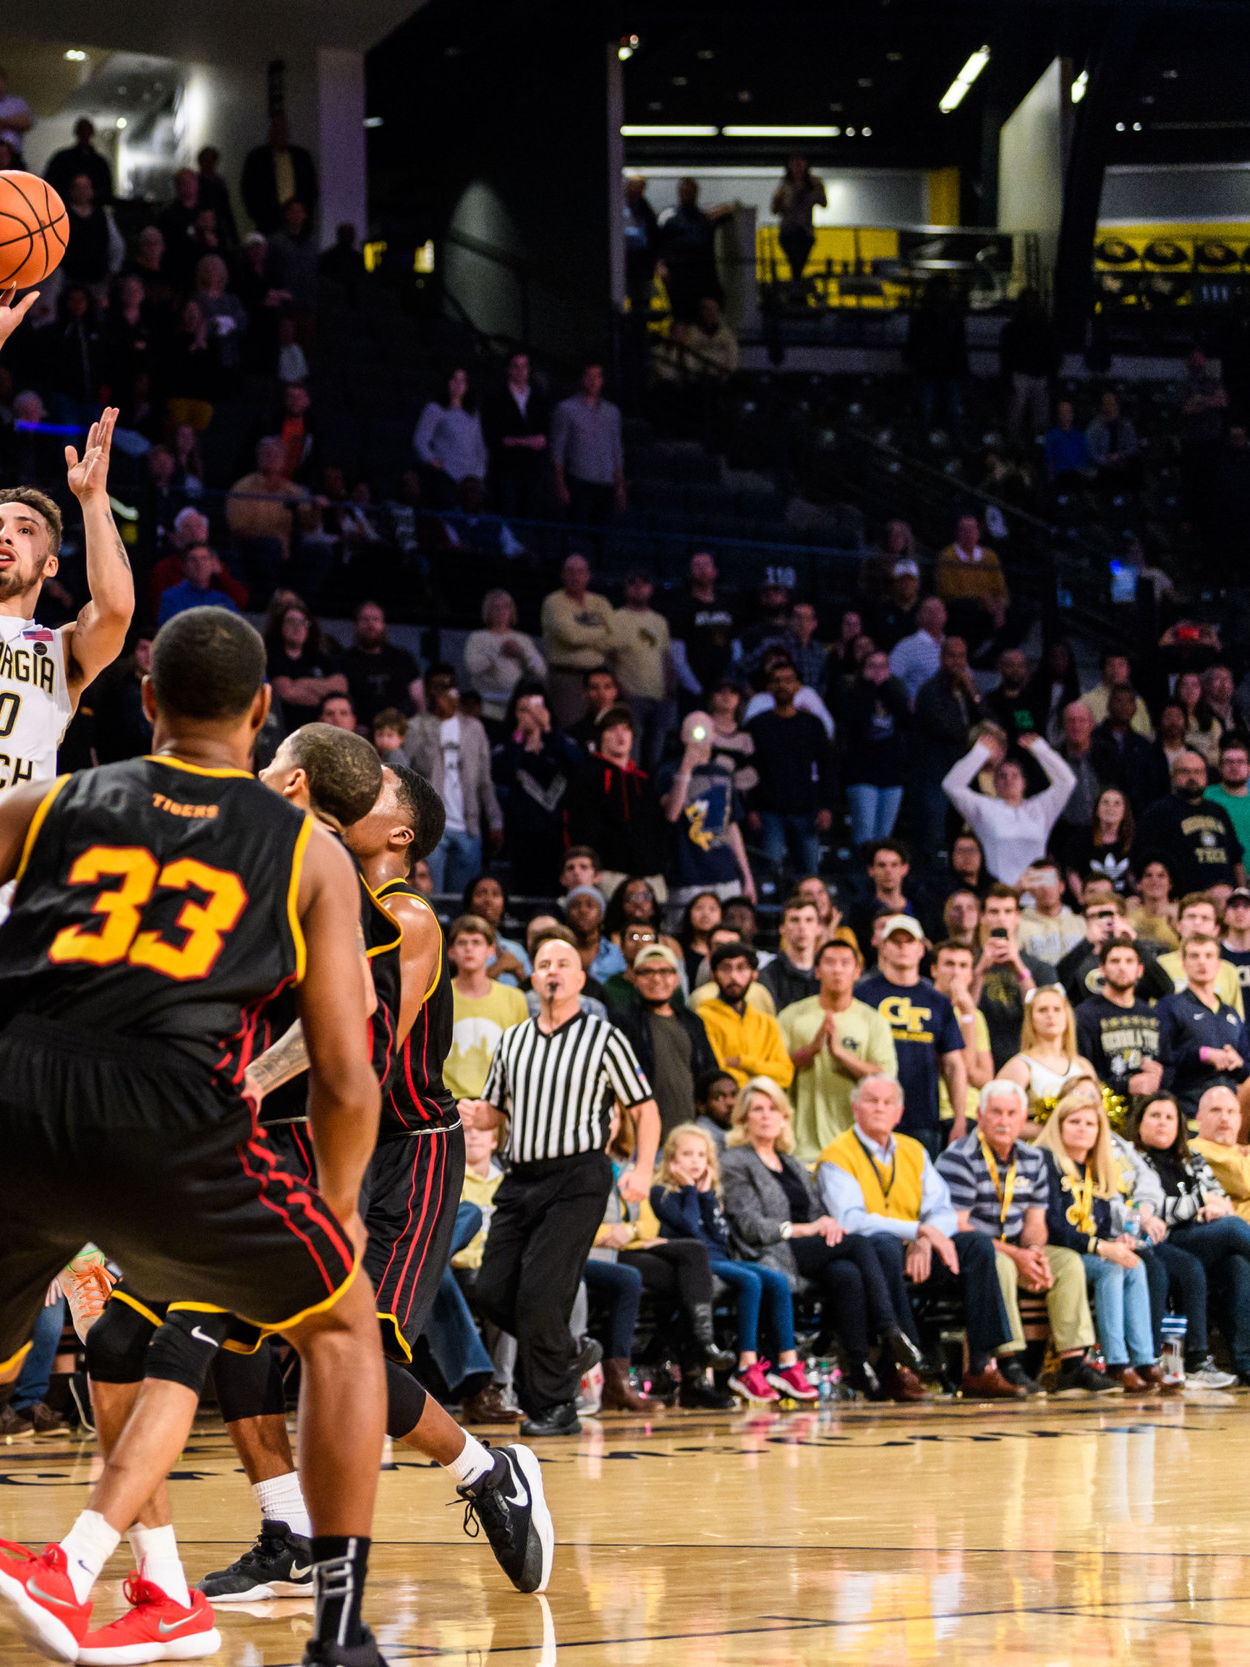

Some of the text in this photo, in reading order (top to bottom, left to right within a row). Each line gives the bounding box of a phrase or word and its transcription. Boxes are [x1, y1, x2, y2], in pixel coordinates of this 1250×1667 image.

[152, 793, 219, 819] TIGERS
[48, 844, 249, 981] 33
[878, 996, 932, 1032] GT
